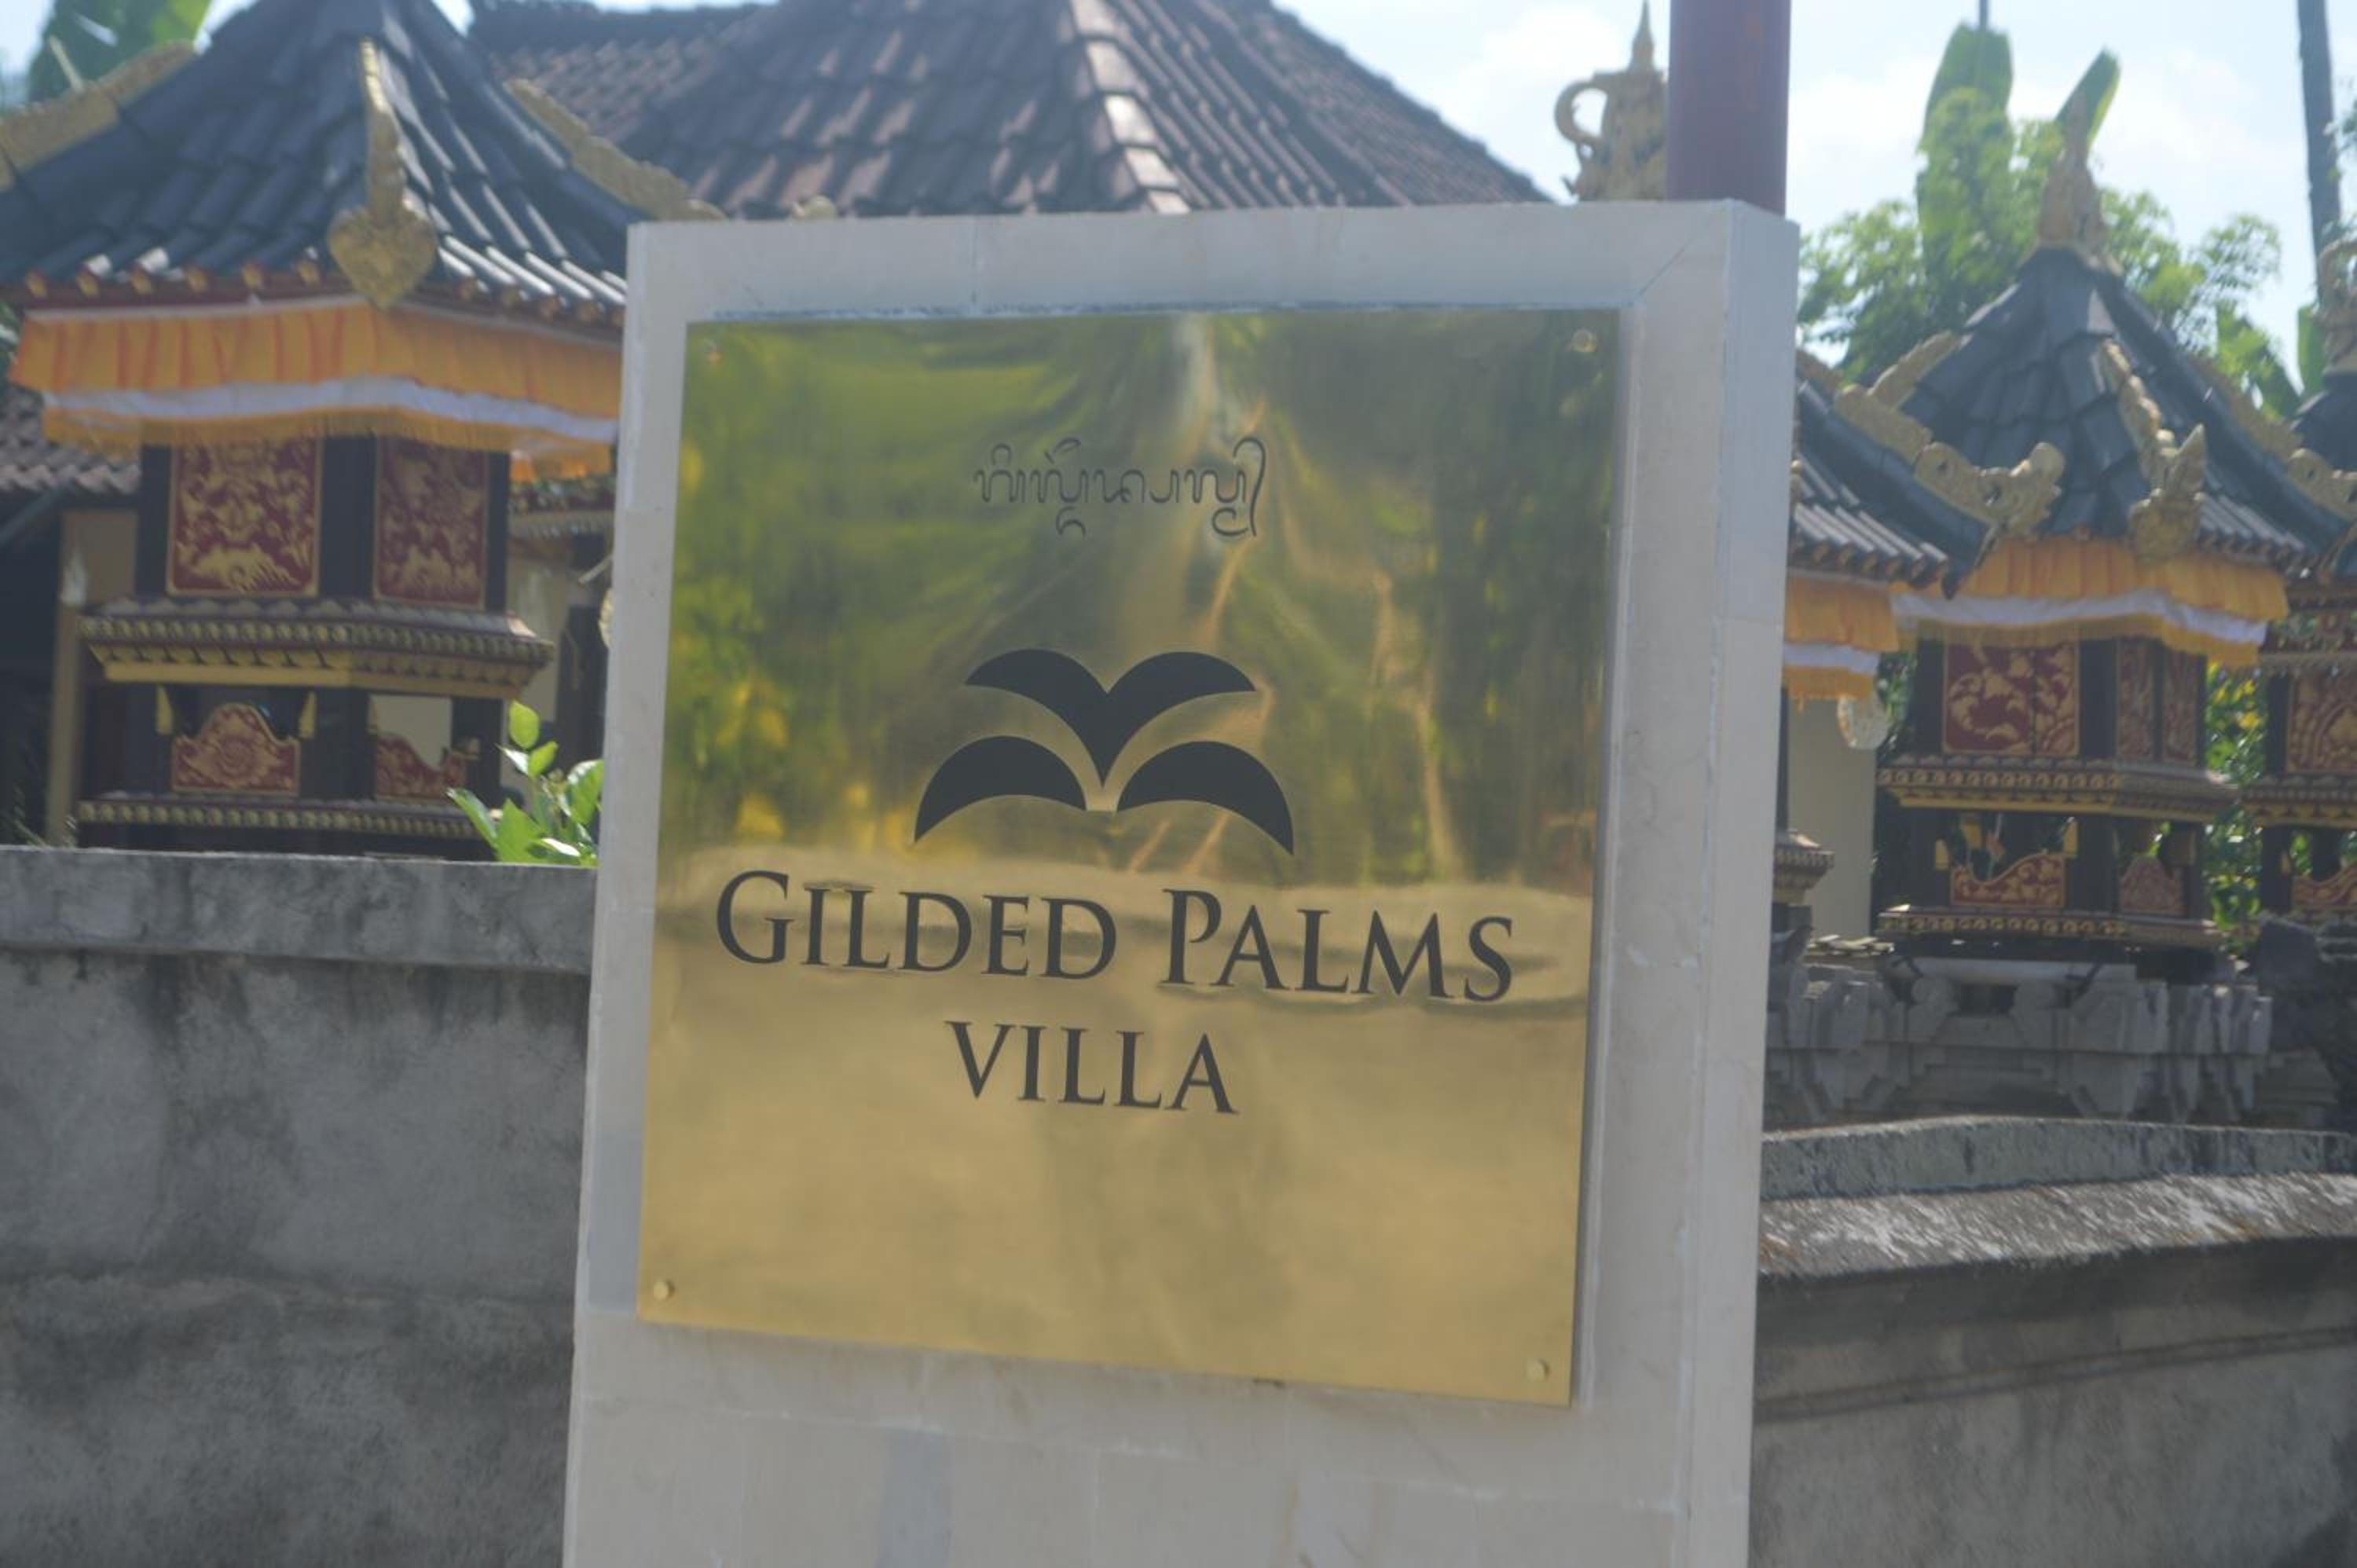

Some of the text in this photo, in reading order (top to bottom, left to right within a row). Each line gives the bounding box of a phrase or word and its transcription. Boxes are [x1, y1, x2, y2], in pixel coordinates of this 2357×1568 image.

[716, 869, 1515, 1002] GILDED PALMS
[945, 1020, 1240, 1115] VILLA
